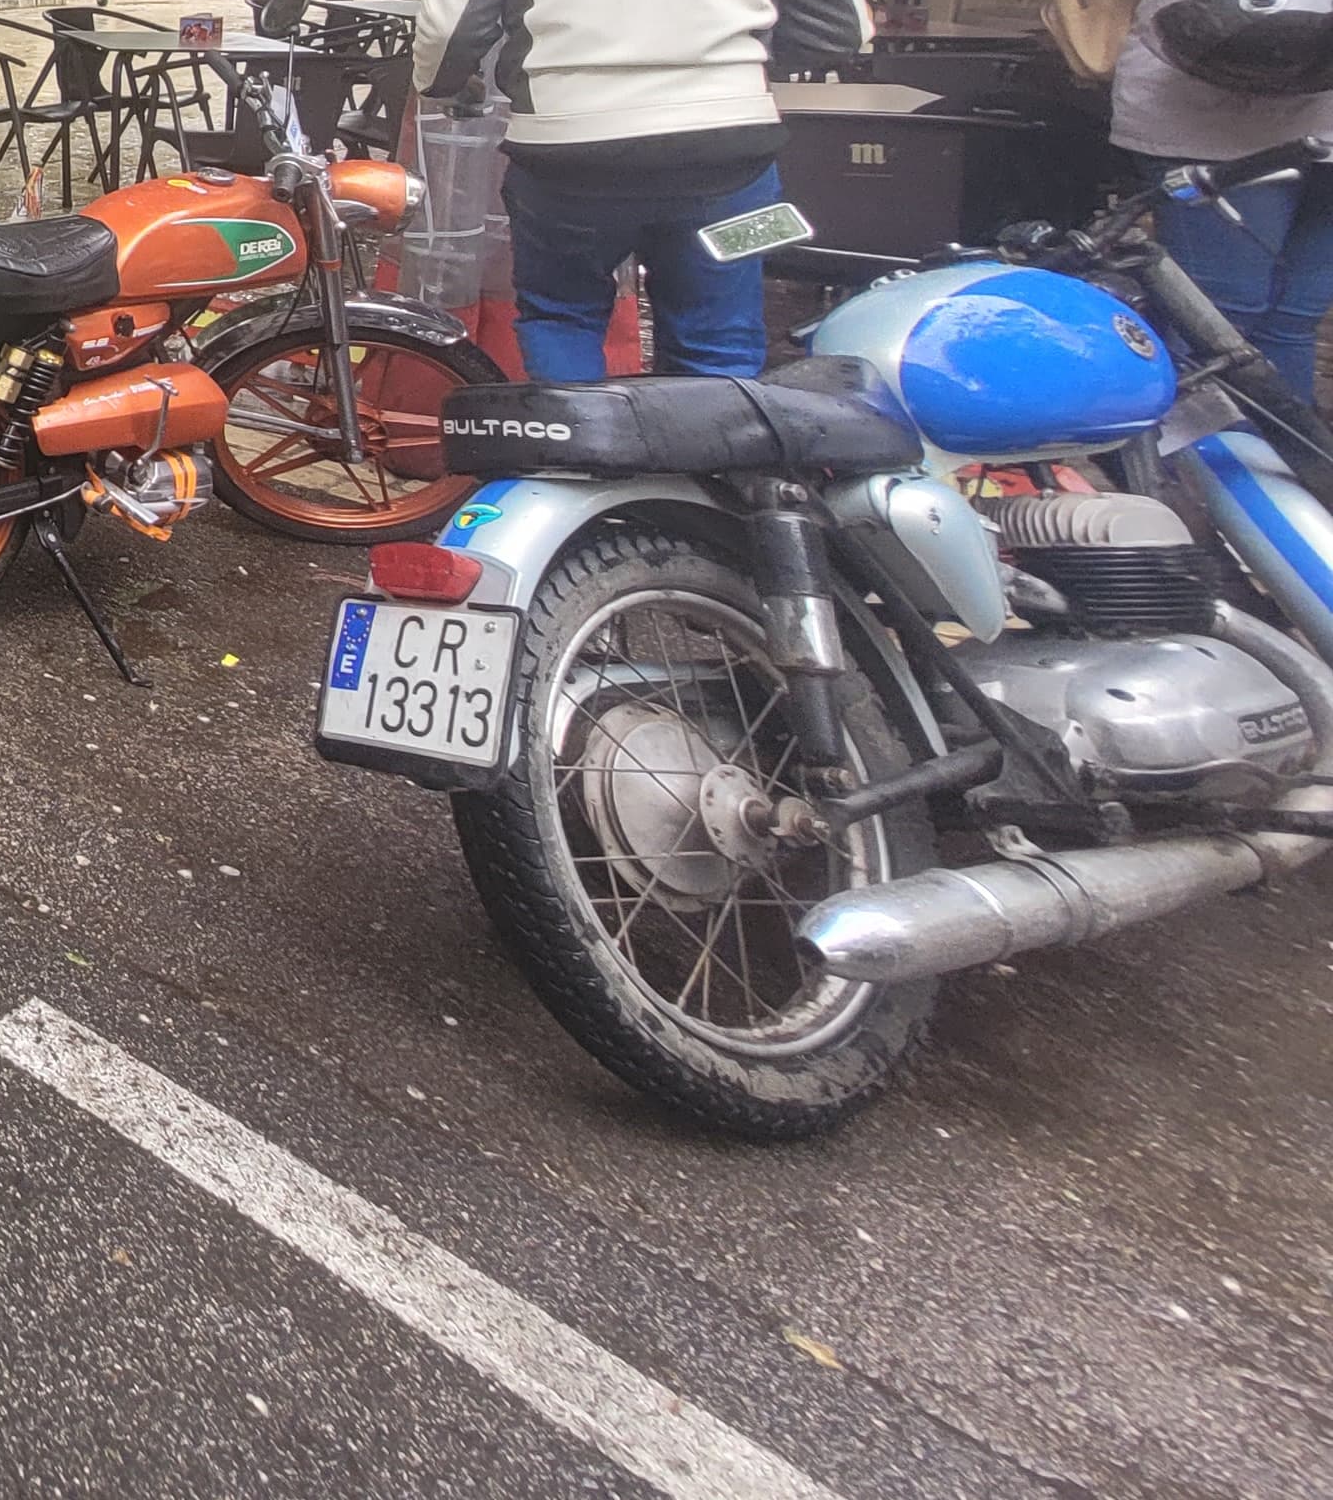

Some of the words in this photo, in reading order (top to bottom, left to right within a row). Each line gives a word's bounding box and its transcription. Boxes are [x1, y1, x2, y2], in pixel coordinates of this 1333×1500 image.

[443, 419, 572, 441] BULTACO
[340, 653, 357, 674] E
[365, 673, 493, 748] 13313
